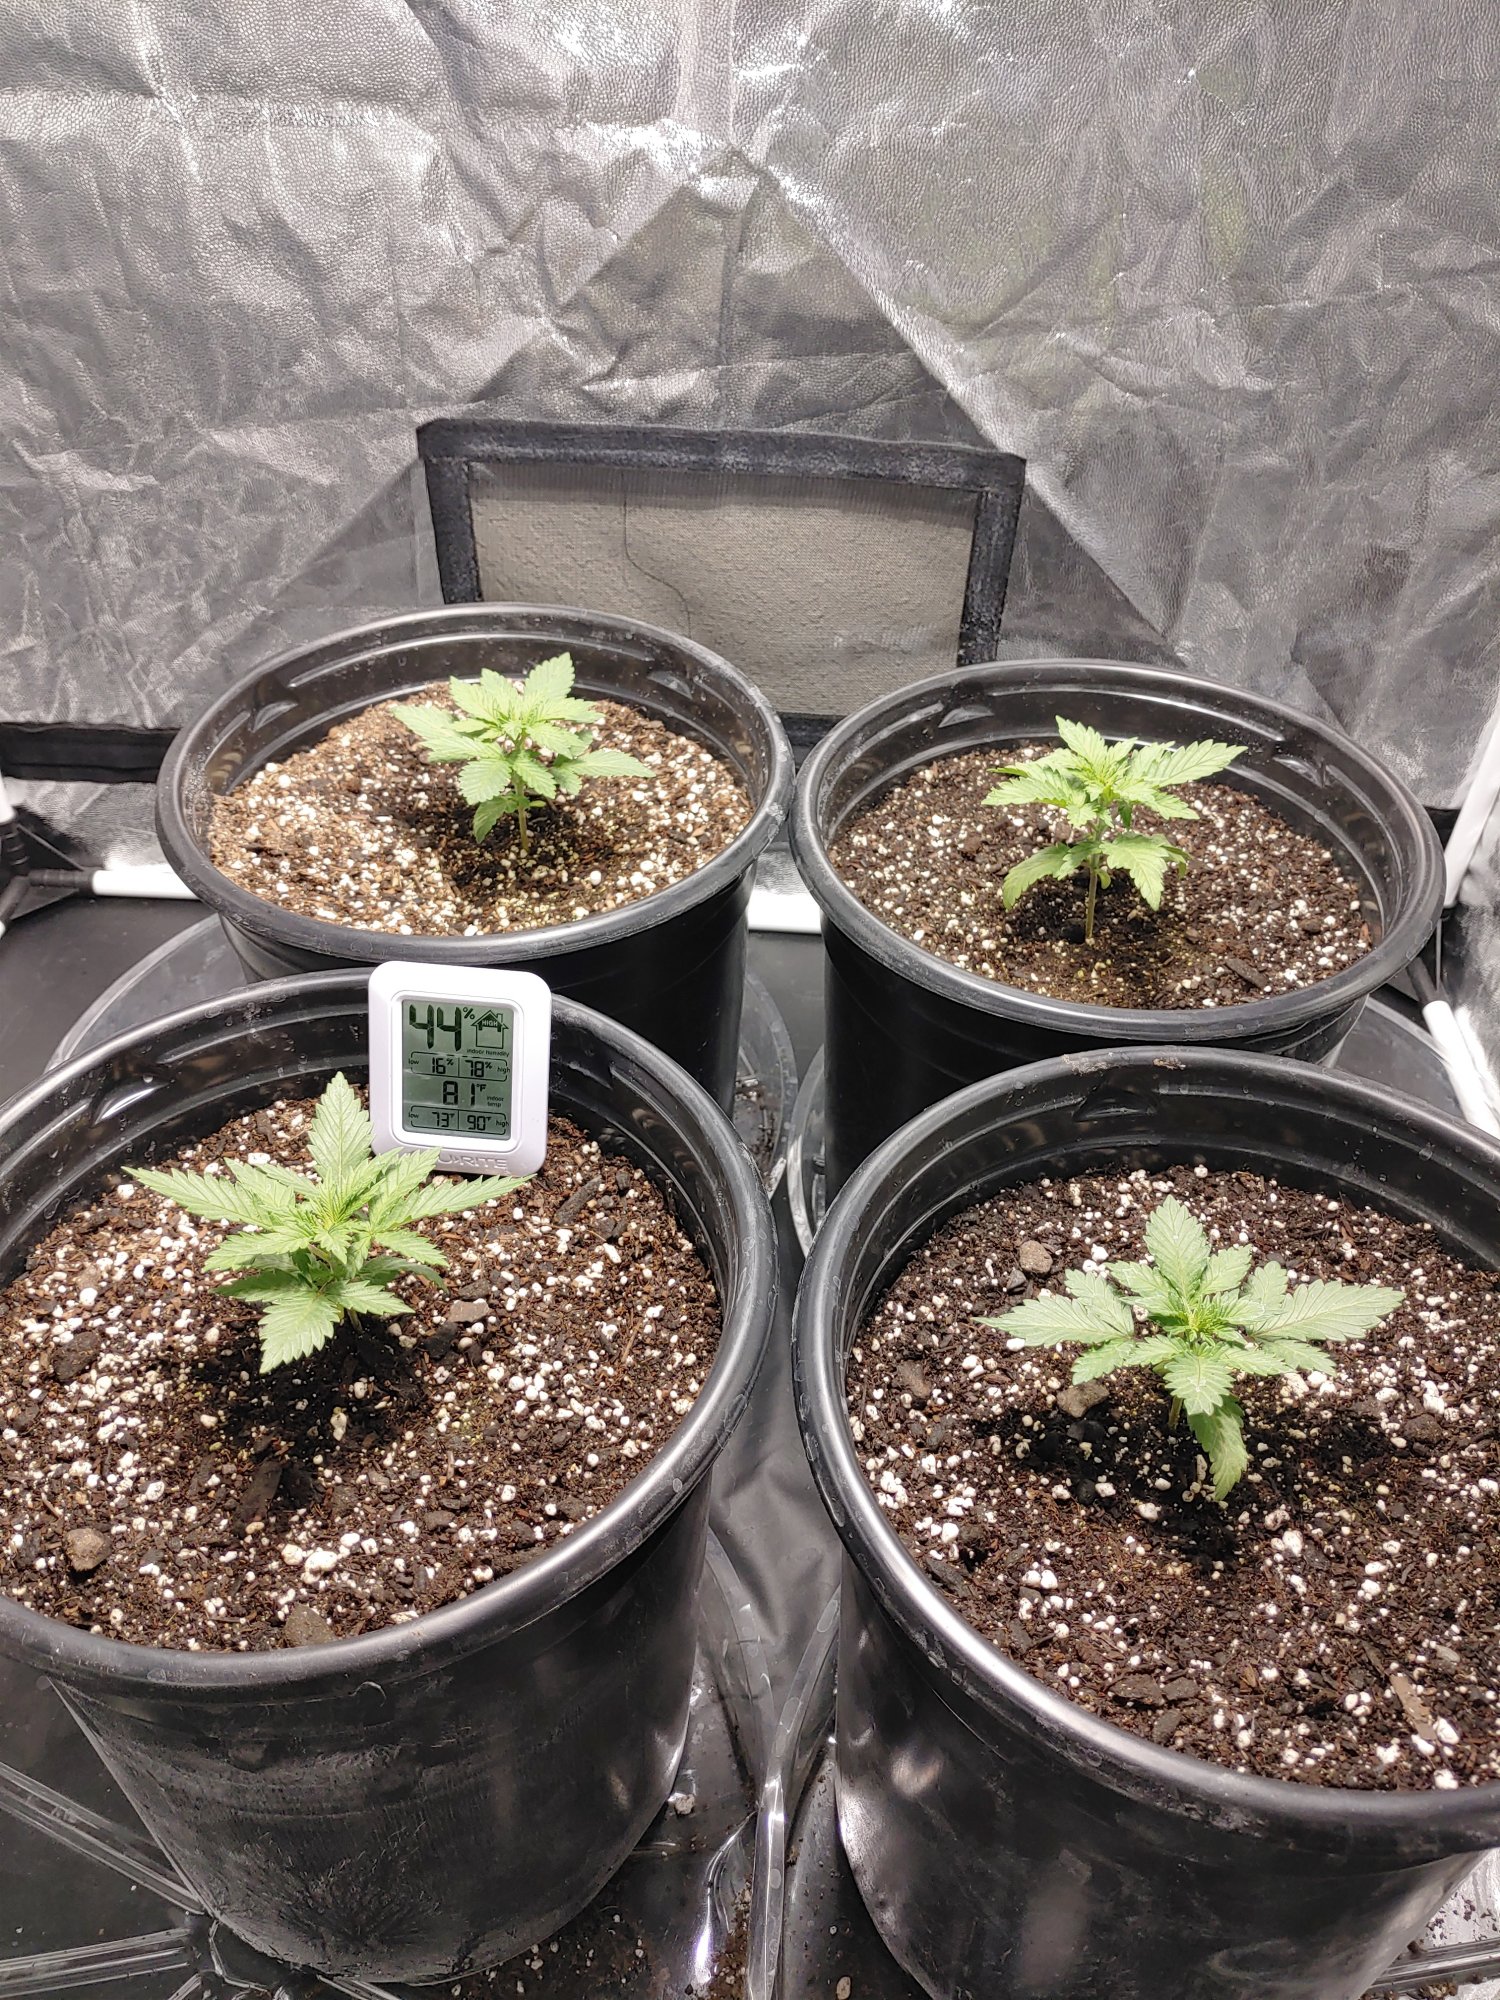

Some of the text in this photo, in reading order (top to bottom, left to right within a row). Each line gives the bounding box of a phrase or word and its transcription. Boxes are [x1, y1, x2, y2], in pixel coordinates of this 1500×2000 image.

[482, 1019, 498, 1027] HIGH
[497, 1066, 510, 1074] high
[495, 1119, 510, 1127] high
